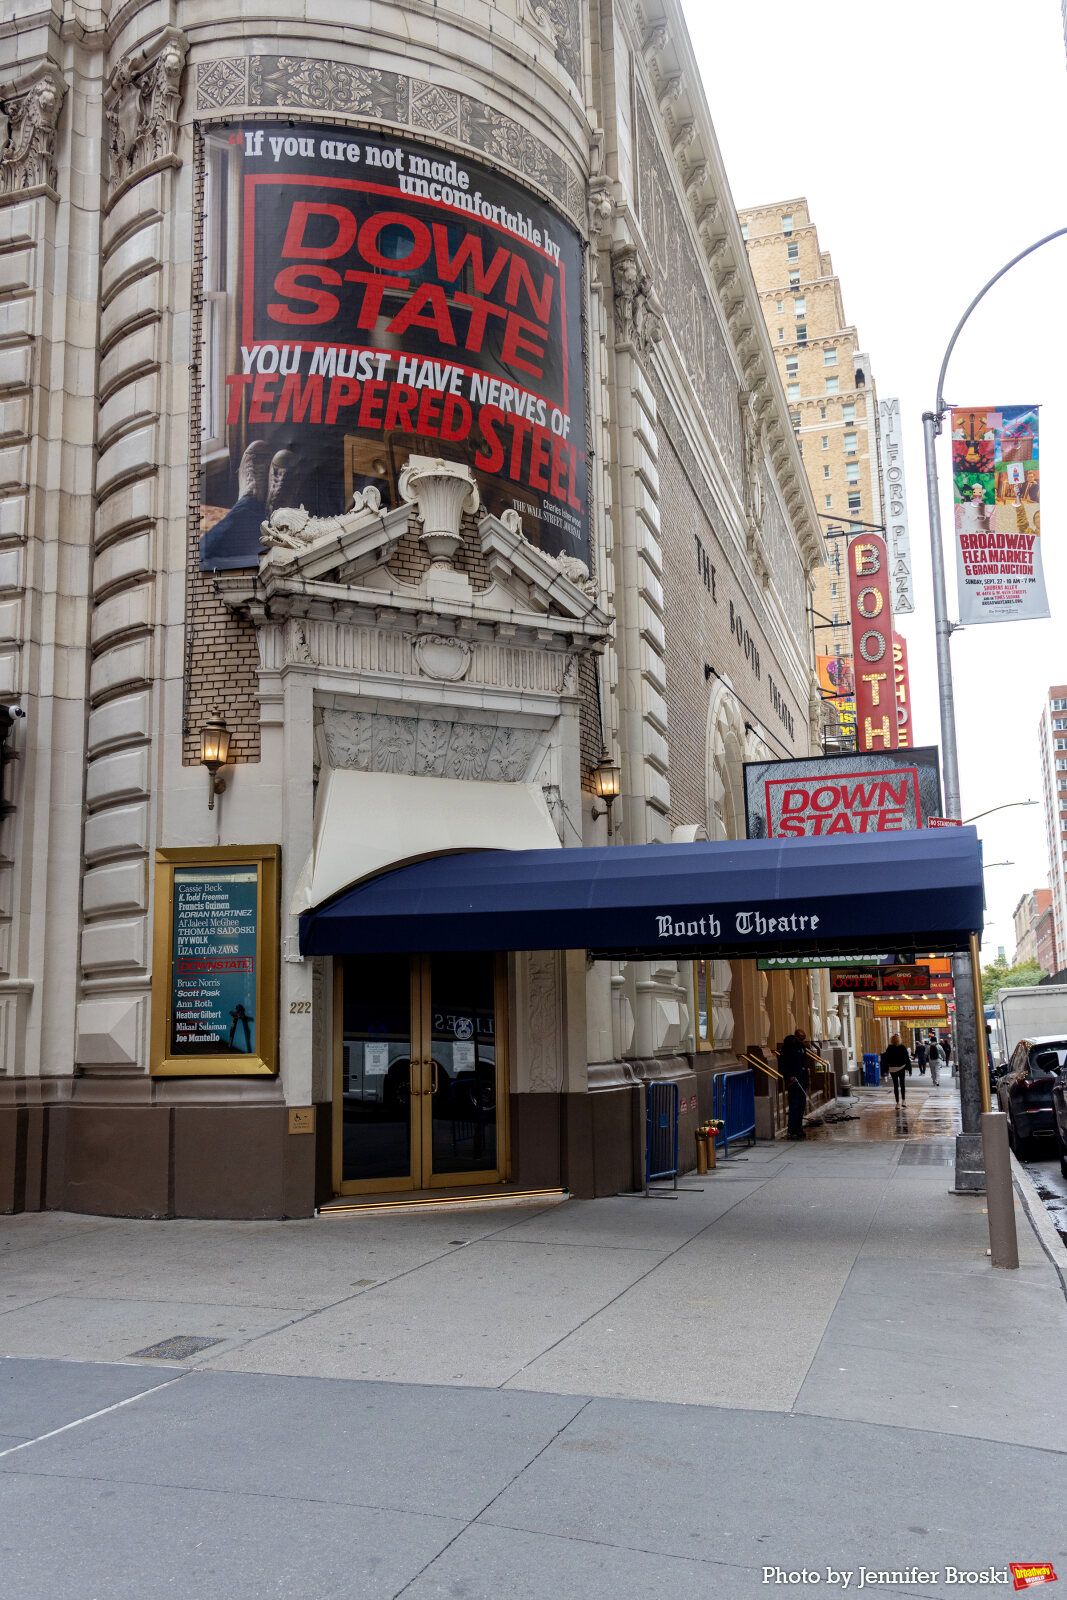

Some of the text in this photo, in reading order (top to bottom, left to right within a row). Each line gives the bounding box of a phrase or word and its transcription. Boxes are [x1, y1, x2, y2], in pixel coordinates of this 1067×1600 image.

[269, 136, 315, 162] you
[320, 139, 361, 163] are
[365, 146, 404, 172] not
[408, 154, 470, 190] made
[398, 173, 561, 267] uncomfortable by
[280, 200, 554, 325] DOWN
[266, 264, 549, 380] STATE
[240, 344, 571, 440] YOU MUST HAVE NERVES OF
[225, 372, 473, 442] TEMPERED
[543, 499, 562, 516] Charles
[879, 400, 913, 611] MILFORD PLAZA
[512, 498, 527, 513] THE
[526, 503, 543, 520] WALL
[543, 510, 563, 529] STREET
[959, 533, 1036, 551] BROADWAY
[962, 550, 1034, 564] FLEA MARKET
[965, 563, 1034, 576] & GRAND AUCTION
[694, 533, 795, 743] THE BOOTH THEATRE
[855, 543, 891, 750] BOOTH
[781, 779, 909, 815] DOWN
[777, 807, 906, 838] STATE
[178, 883, 223, 893] Cassie Beck
[186, 893, 201, 901] Todd
[201, 893, 229, 901] Freeman
[178, 901, 205, 911] Francis
[178, 909, 253, 919] ADRIAN MARTINEZ
[209, 918, 240, 926] McGhee
[655, 911, 820, 938] Booth Theatre
[178, 926, 256, 936] THOMAS SADOSKI
[177, 936, 209, 945] IVY WOLK
[177, 945, 193, 956] LIZA
[176, 978, 221, 988] Bruce Norris
[177, 989, 221, 998] Scott Pask
[176, 999, 213, 1008] Ann Roth
[289, 1001, 312, 1014] 222
[176, 1010, 221, 1019] Heather Gilbert
[176, 1033, 220, 1043] Joe Mantello
